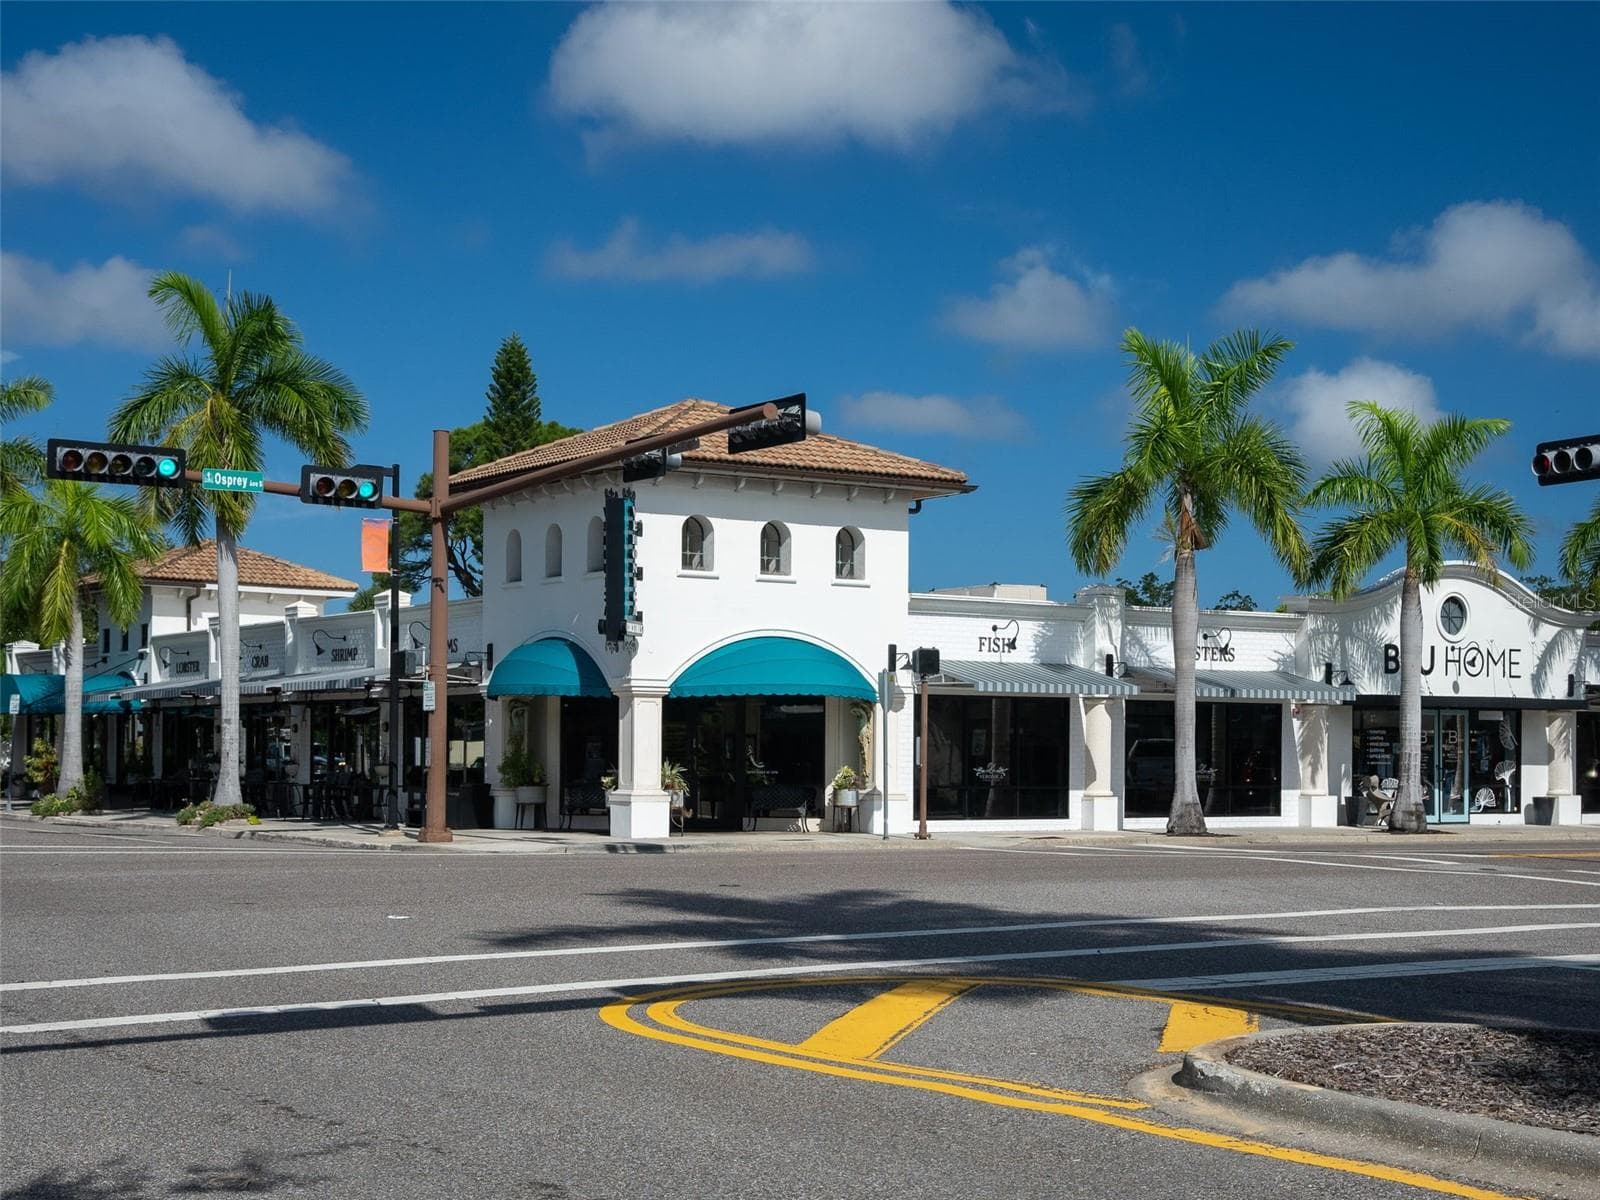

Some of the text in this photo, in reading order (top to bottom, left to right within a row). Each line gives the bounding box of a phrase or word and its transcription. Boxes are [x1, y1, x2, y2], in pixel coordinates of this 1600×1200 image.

[214, 472, 248, 489] Osprey
[978, 636, 1012, 653] FISH
[331, 647, 358, 661] SHRIMP
[1194, 645, 1236, 662] STERS
[1384, 643, 1521, 679] BU HOME
[175, 661, 200, 674] LOBSTER
